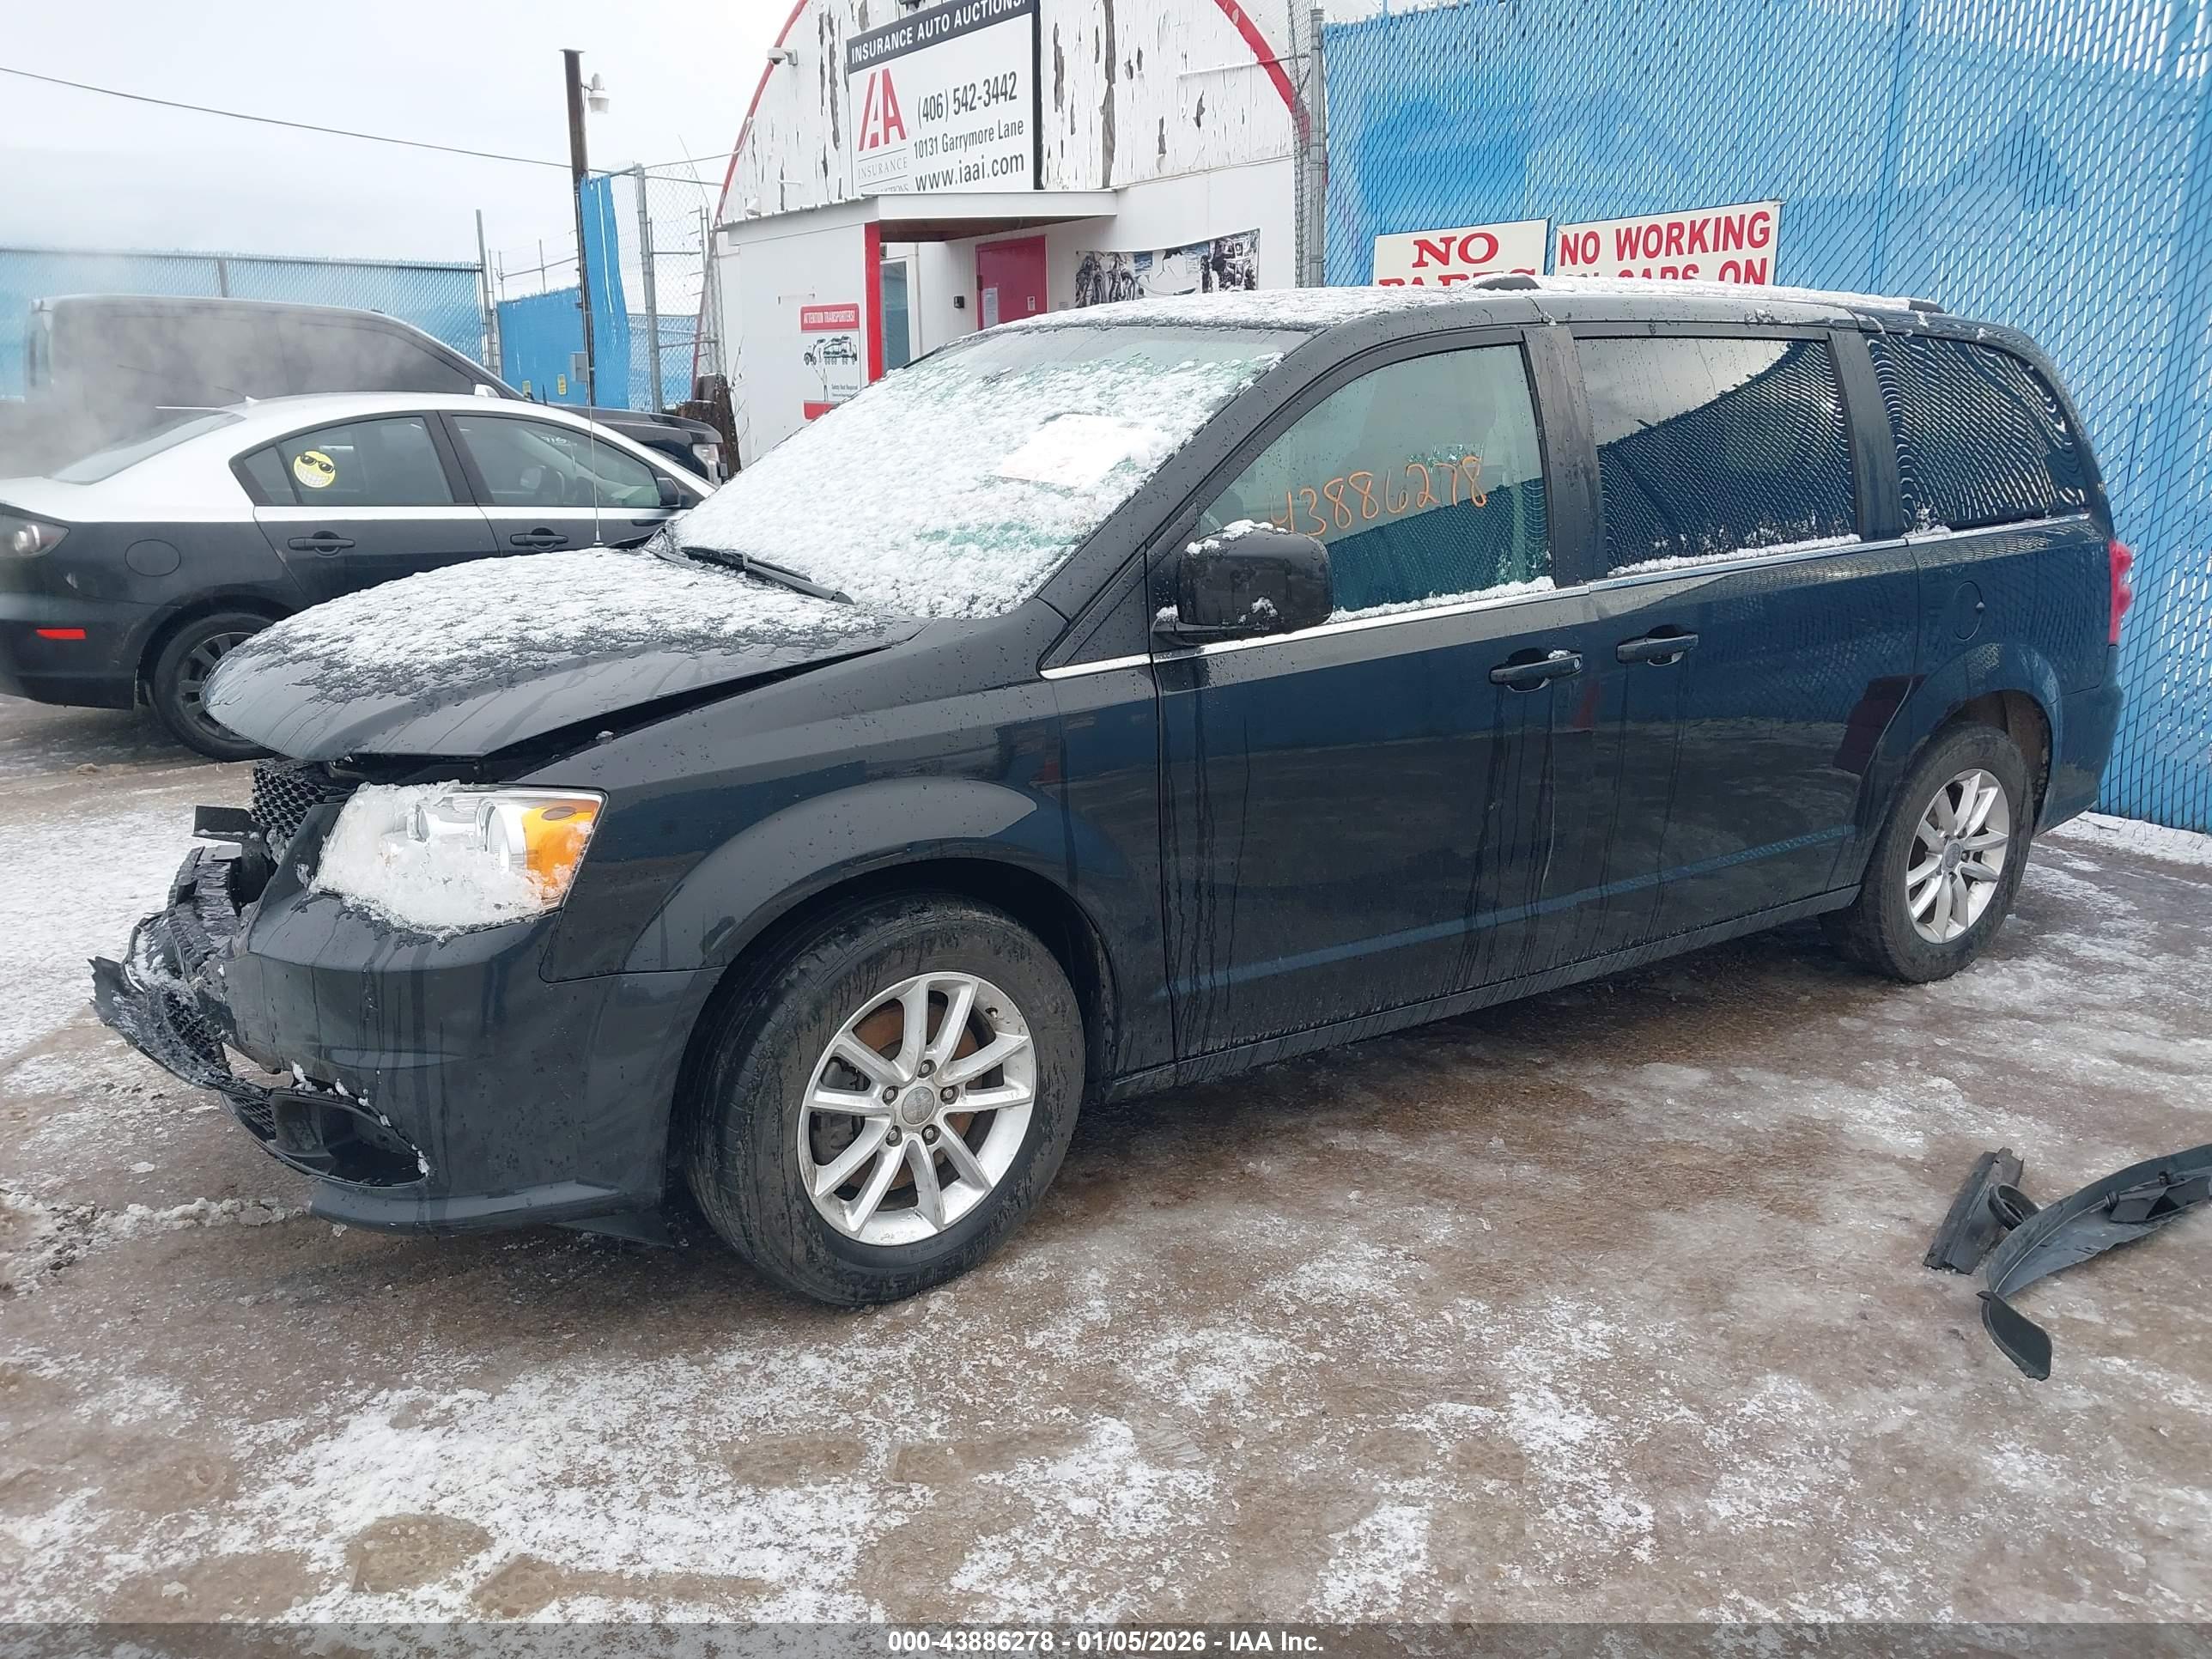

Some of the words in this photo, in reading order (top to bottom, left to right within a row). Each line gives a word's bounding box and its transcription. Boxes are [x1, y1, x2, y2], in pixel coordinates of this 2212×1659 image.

[851, 27, 913, 64] INSURANCE
[917, 13, 950, 41] AUTO
[917, 88, 949, 129] (406)
[953, 70, 1018, 115] 542-3442
[914, 137, 939, 159] 10131
[942, 125, 994, 154] Garrymore
[998, 118, 1024, 139] Lane
[859, 156, 908, 179] INSURANCE
[915, 153, 1024, 191] www.iaai.com
[1412, 232, 1499, 268] NO
[1559, 231, 1601, 267] NO
[1615, 210, 1771, 262] WORKING
[1718, 258, 1767, 285] ON
[1270, 454, 1488, 537] 43886278
